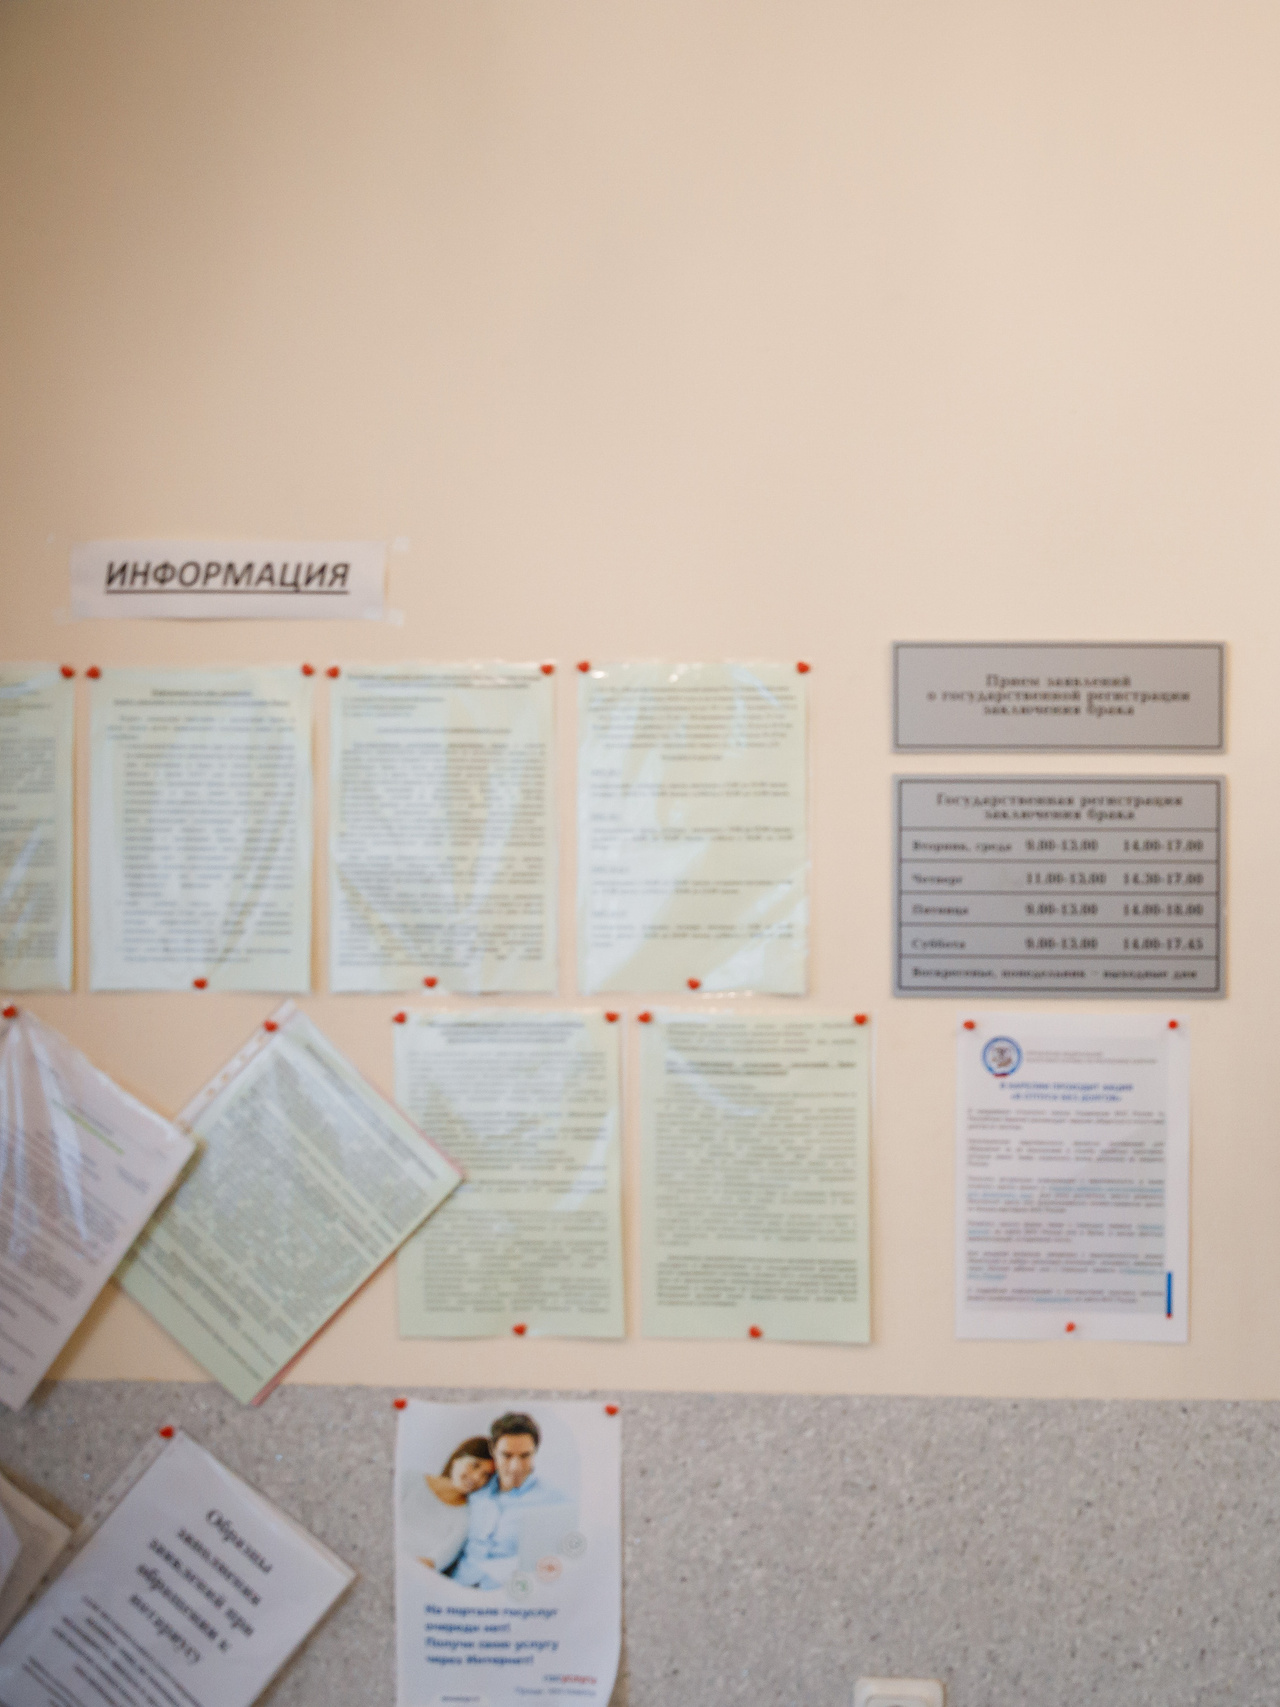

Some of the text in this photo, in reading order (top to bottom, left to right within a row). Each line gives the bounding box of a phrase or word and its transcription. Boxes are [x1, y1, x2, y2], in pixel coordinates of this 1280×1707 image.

[106, 561, 351, 592] ИНФОРМАЦИЯ
[1047, 674, 1131, 687] заявлений
[942, 690, 1081, 703] государственной
[1086, 690, 1190, 704] регистрации
[984, 702, 1135, 718] заключения брака
[936, 793, 1183, 809] Государственная регистрация
[985, 808, 1135, 822] заключения брака
[206, 1509, 272, 1574] Образцы
[177, 1527, 262, 1606] заполнения
[136, 1563, 218, 1641] обращении
[149, 1538, 255, 1637] заявлений при
[130, 1594, 200, 1665] нотариусу
